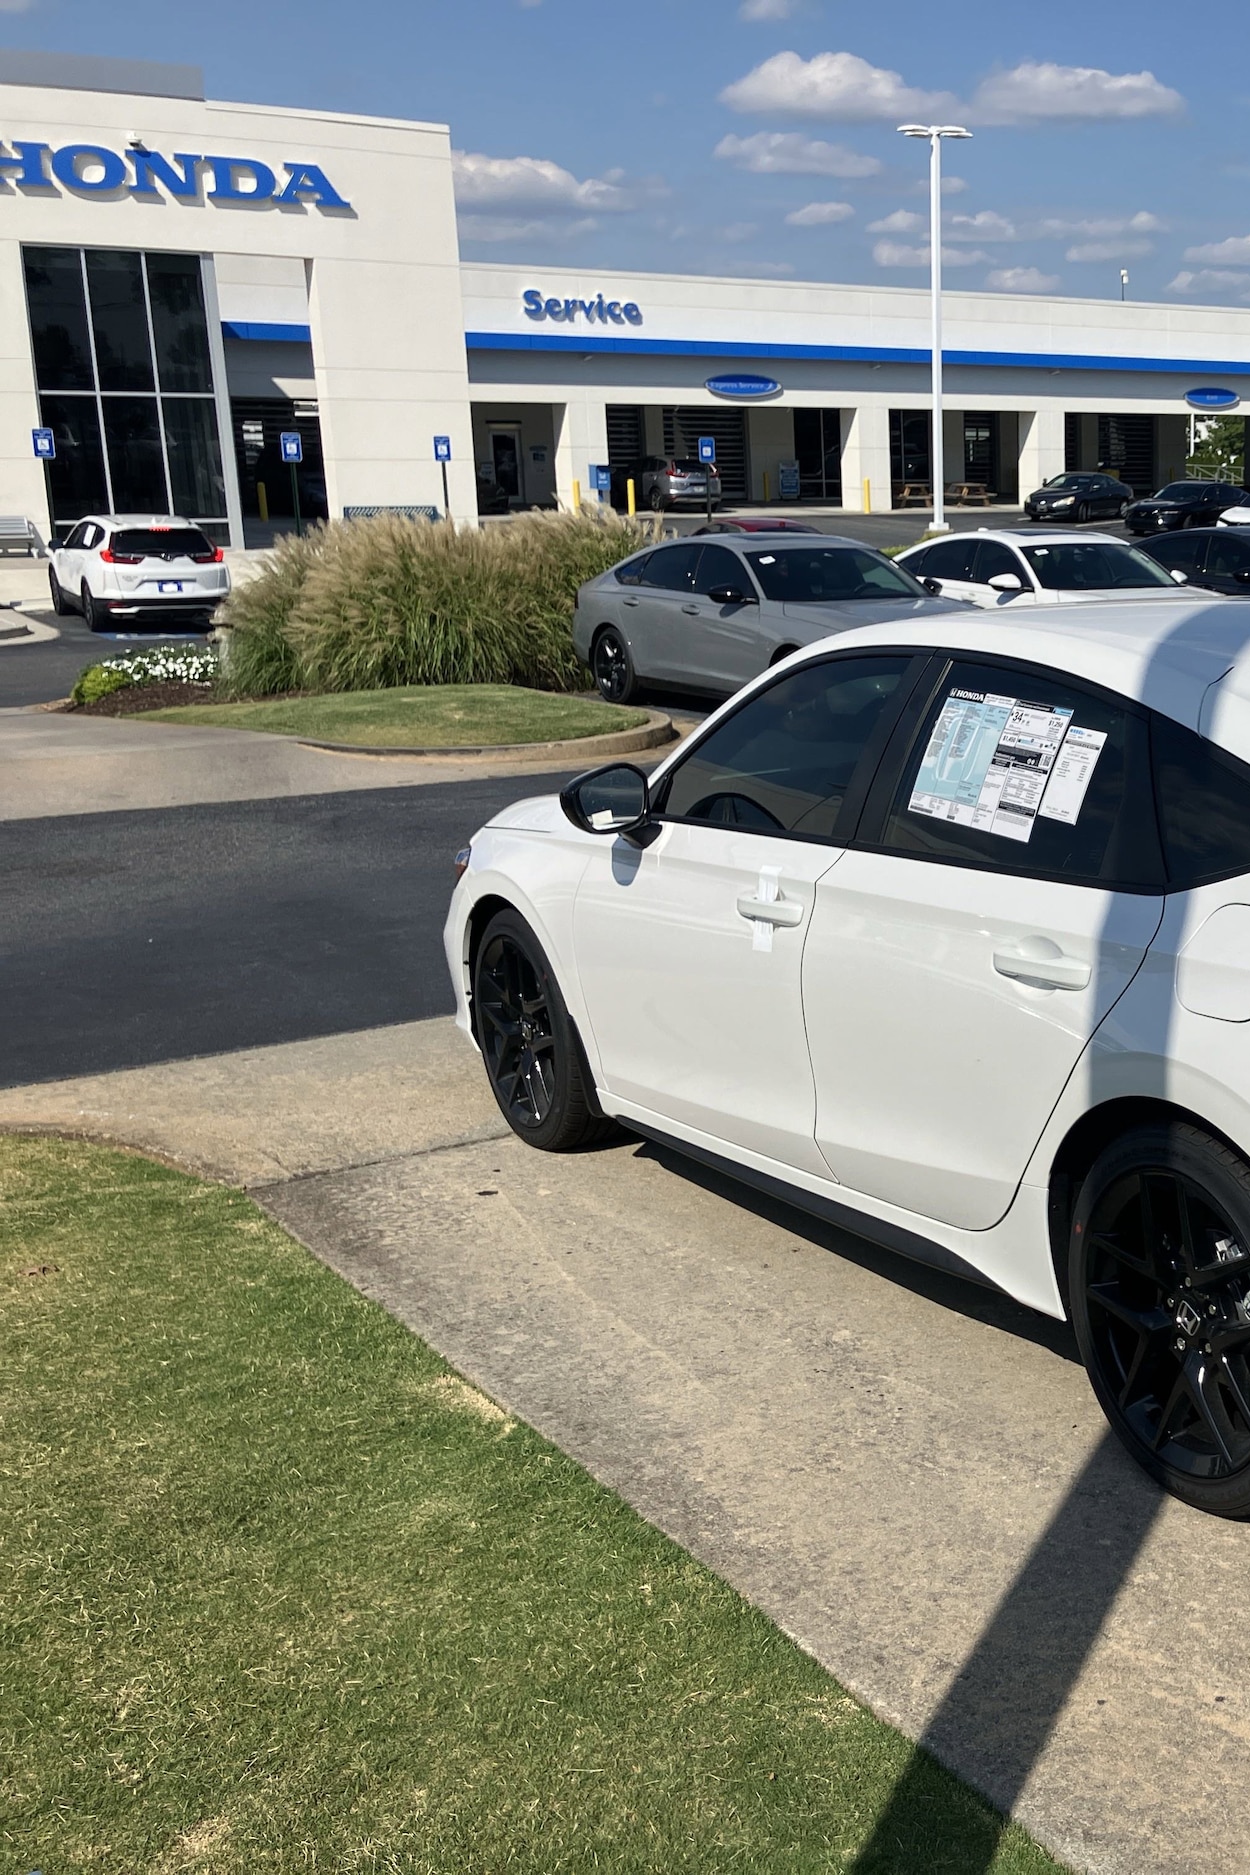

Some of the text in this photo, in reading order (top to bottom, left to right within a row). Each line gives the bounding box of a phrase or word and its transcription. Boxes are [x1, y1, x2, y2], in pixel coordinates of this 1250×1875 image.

[0, 140, 350, 209] HONDA
[523, 289, 641, 320] Service
[956, 689, 985, 702] HONDA
[1012, 711, 1024, 722] 34
